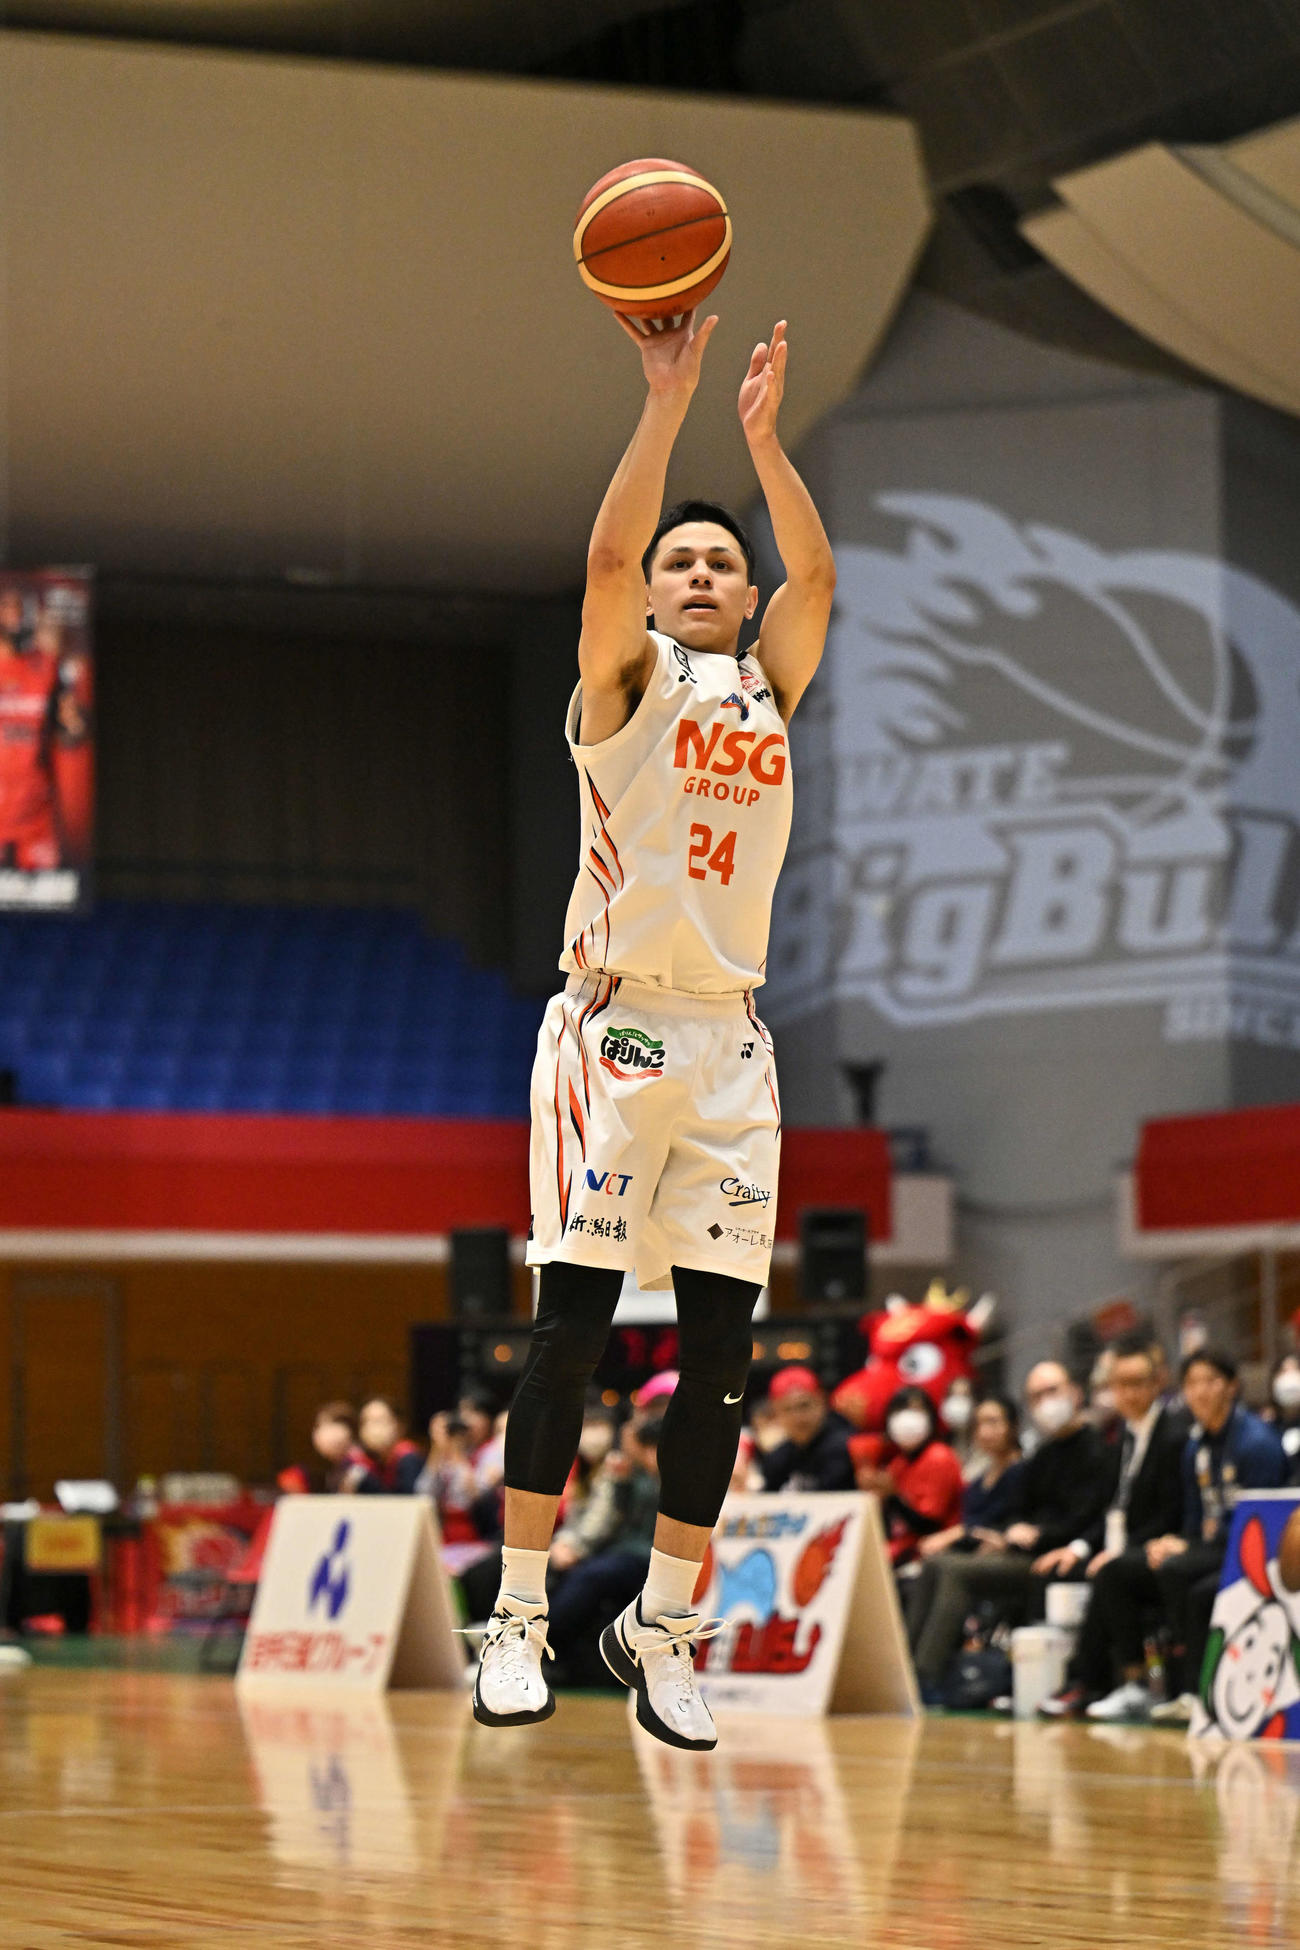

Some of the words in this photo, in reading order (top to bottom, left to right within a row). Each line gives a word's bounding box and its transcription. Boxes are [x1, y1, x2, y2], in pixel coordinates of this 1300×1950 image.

[673, 718, 786, 786] NSG
[684, 776, 760, 808] GROUP
[688, 822, 738, 886] 24
[600, 1035, 666, 1069] ぱりんこ
